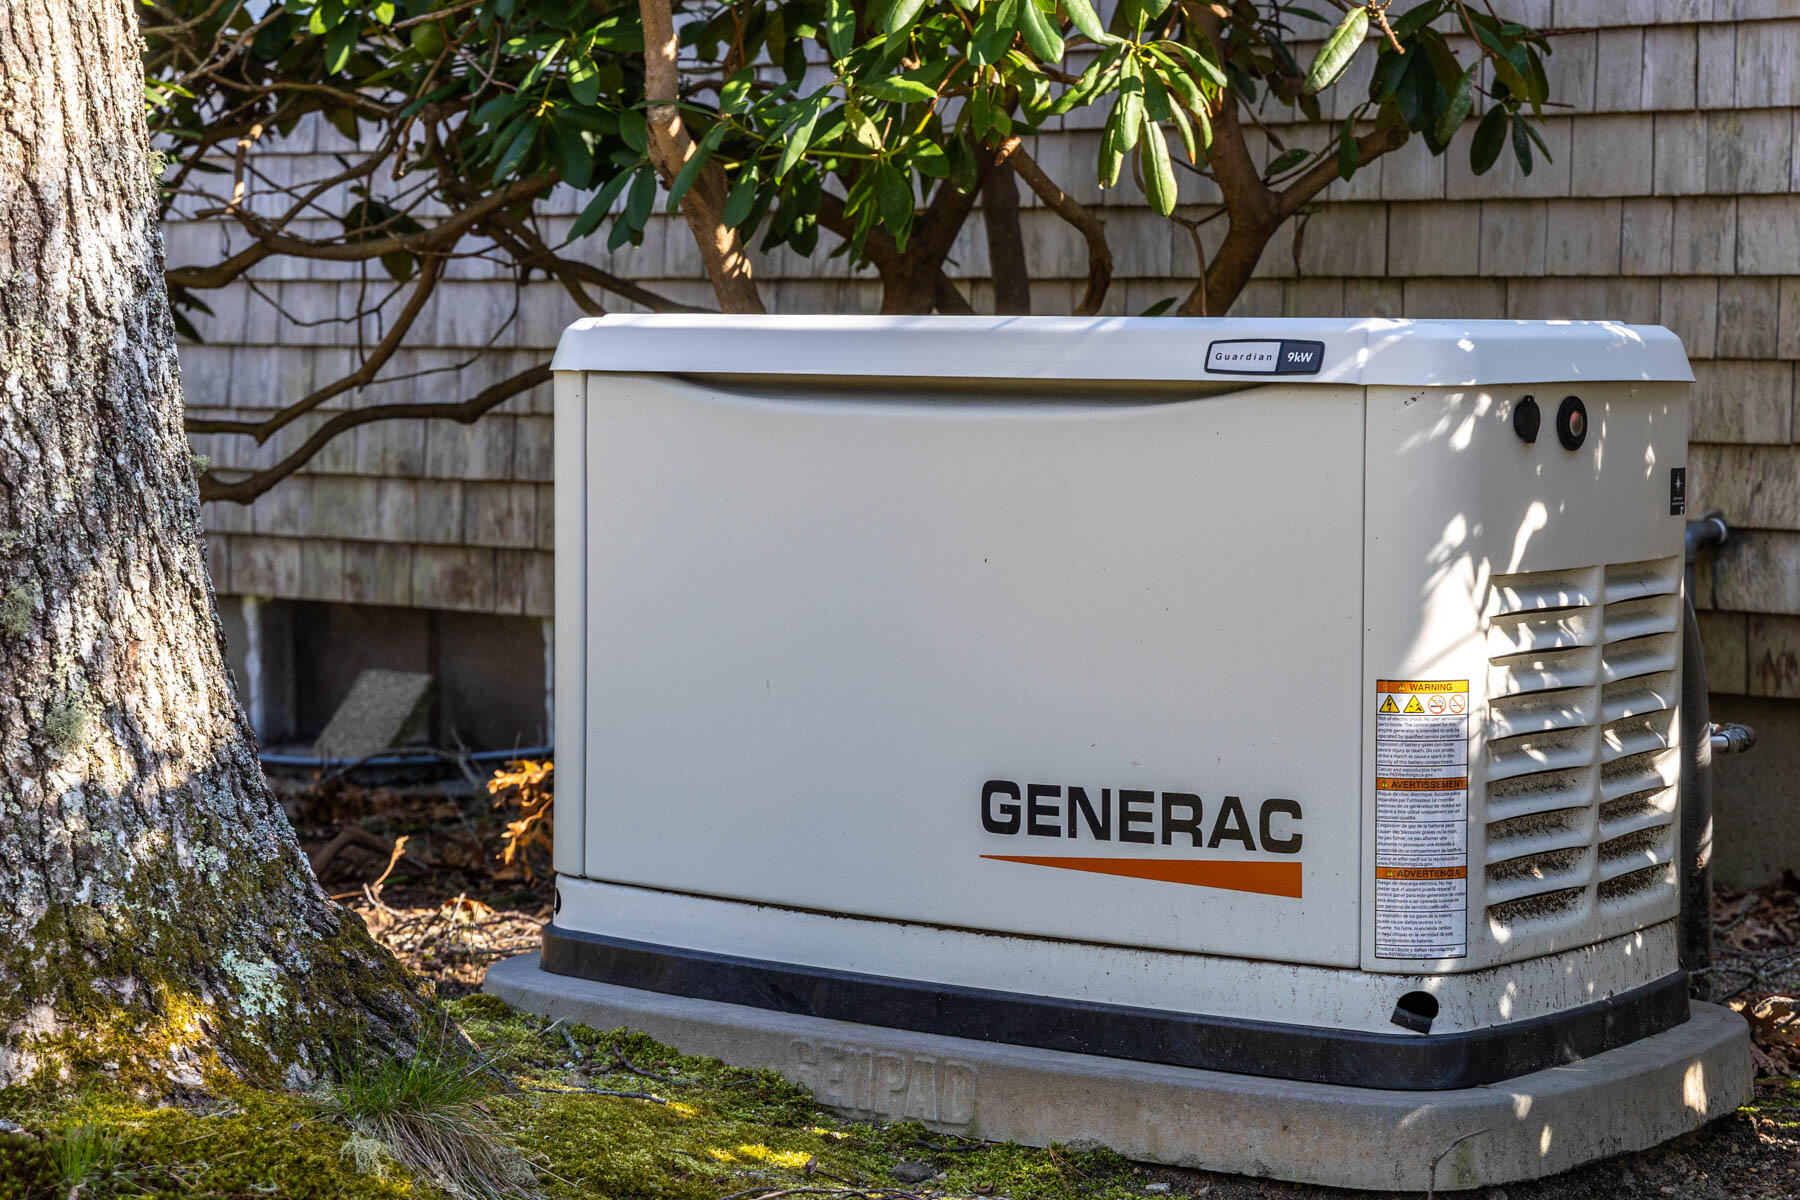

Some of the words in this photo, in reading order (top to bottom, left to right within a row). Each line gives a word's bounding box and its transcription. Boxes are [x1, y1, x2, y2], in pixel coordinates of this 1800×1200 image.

[1215, 352, 1273, 361] Guardian
[1287, 352, 1314, 363] 9kW
[1410, 683, 1452, 691] WARNING
[1391, 780, 1465, 788] AVERTISSEMENT
[981, 779, 1303, 854] GENERAC
[1397, 869, 1460, 878] ADVERTENCIA
